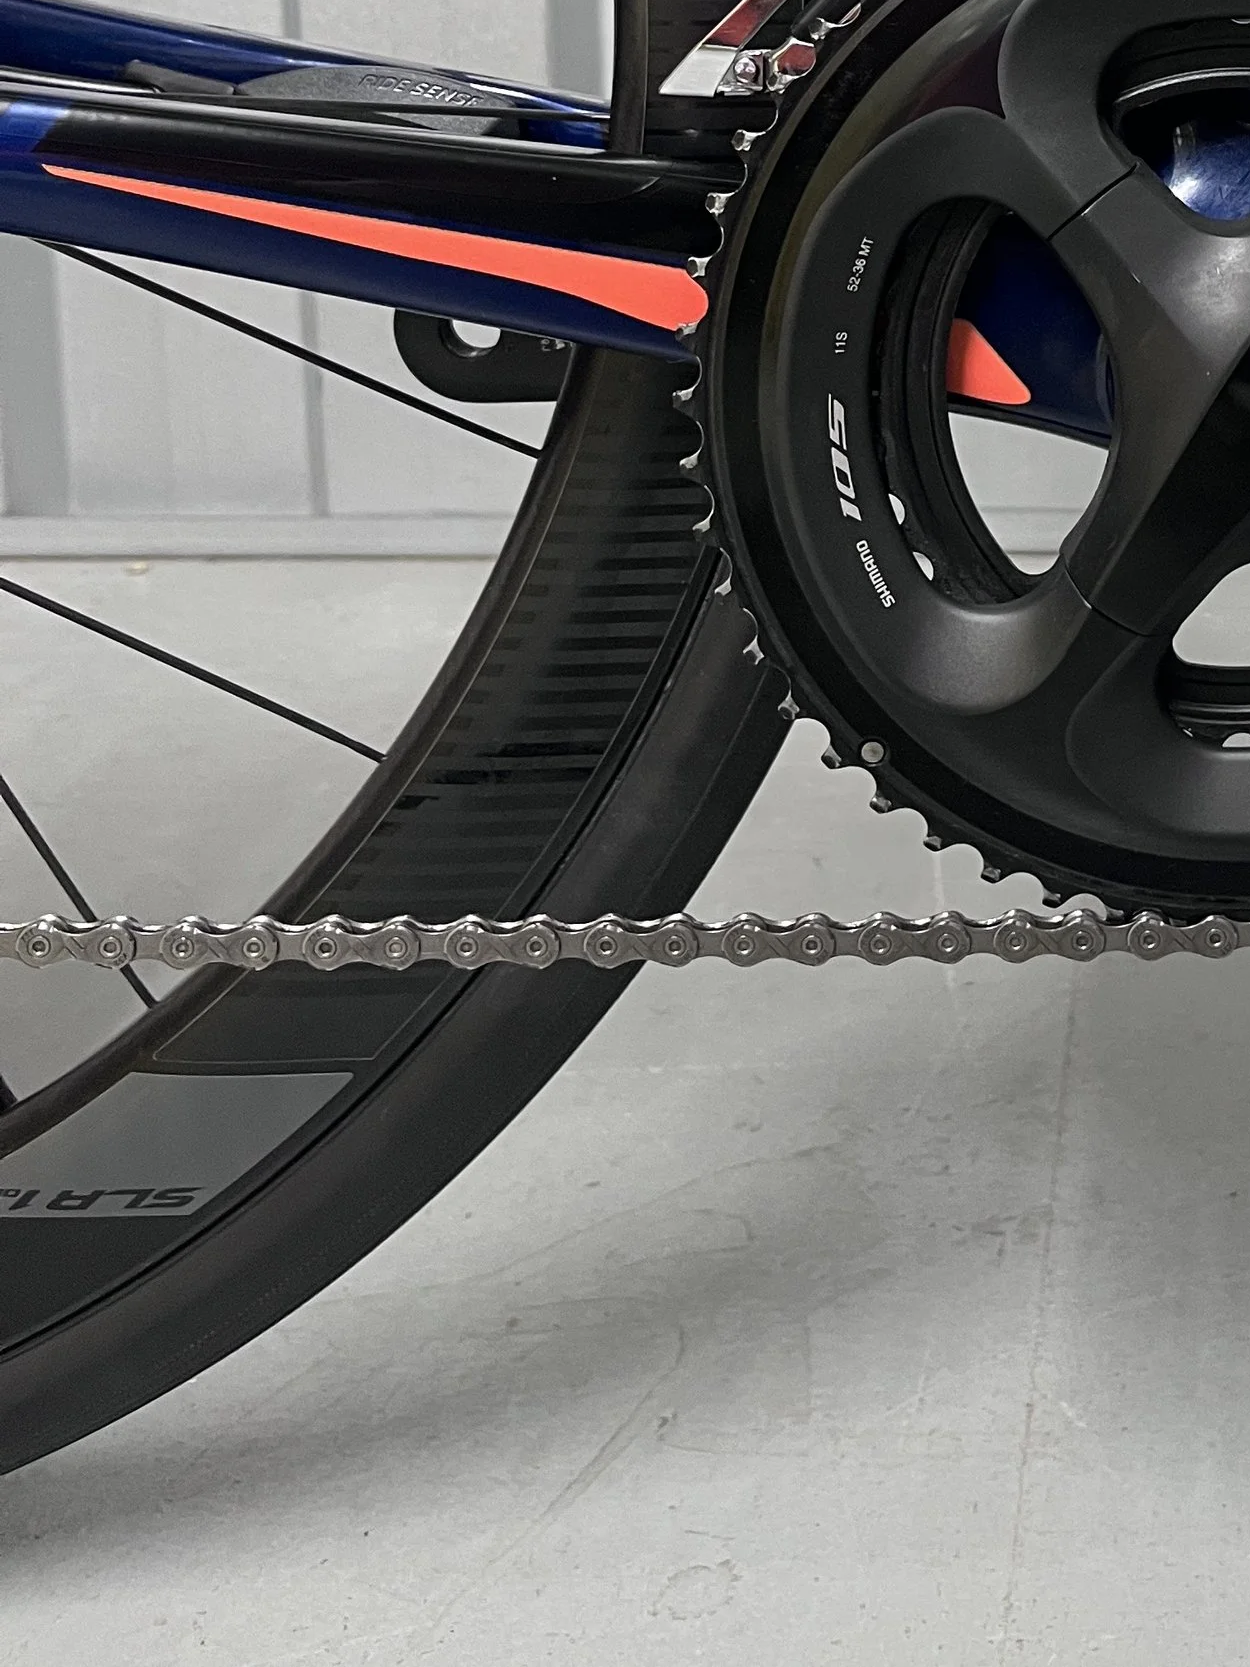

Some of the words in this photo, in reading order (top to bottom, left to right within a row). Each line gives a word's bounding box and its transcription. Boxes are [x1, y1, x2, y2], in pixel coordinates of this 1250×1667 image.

[358, 73, 412, 92] RIDE
[409, 81, 484, 107] SENSE
[846, 257, 867, 293] 52-36
[858, 236, 875, 257] MT
[834, 331, 849, 355] 11S
[827, 392, 863, 522] 105
[855, 539, 896, 609] SHIMANO
[45, 1186, 206, 1211] SLR
